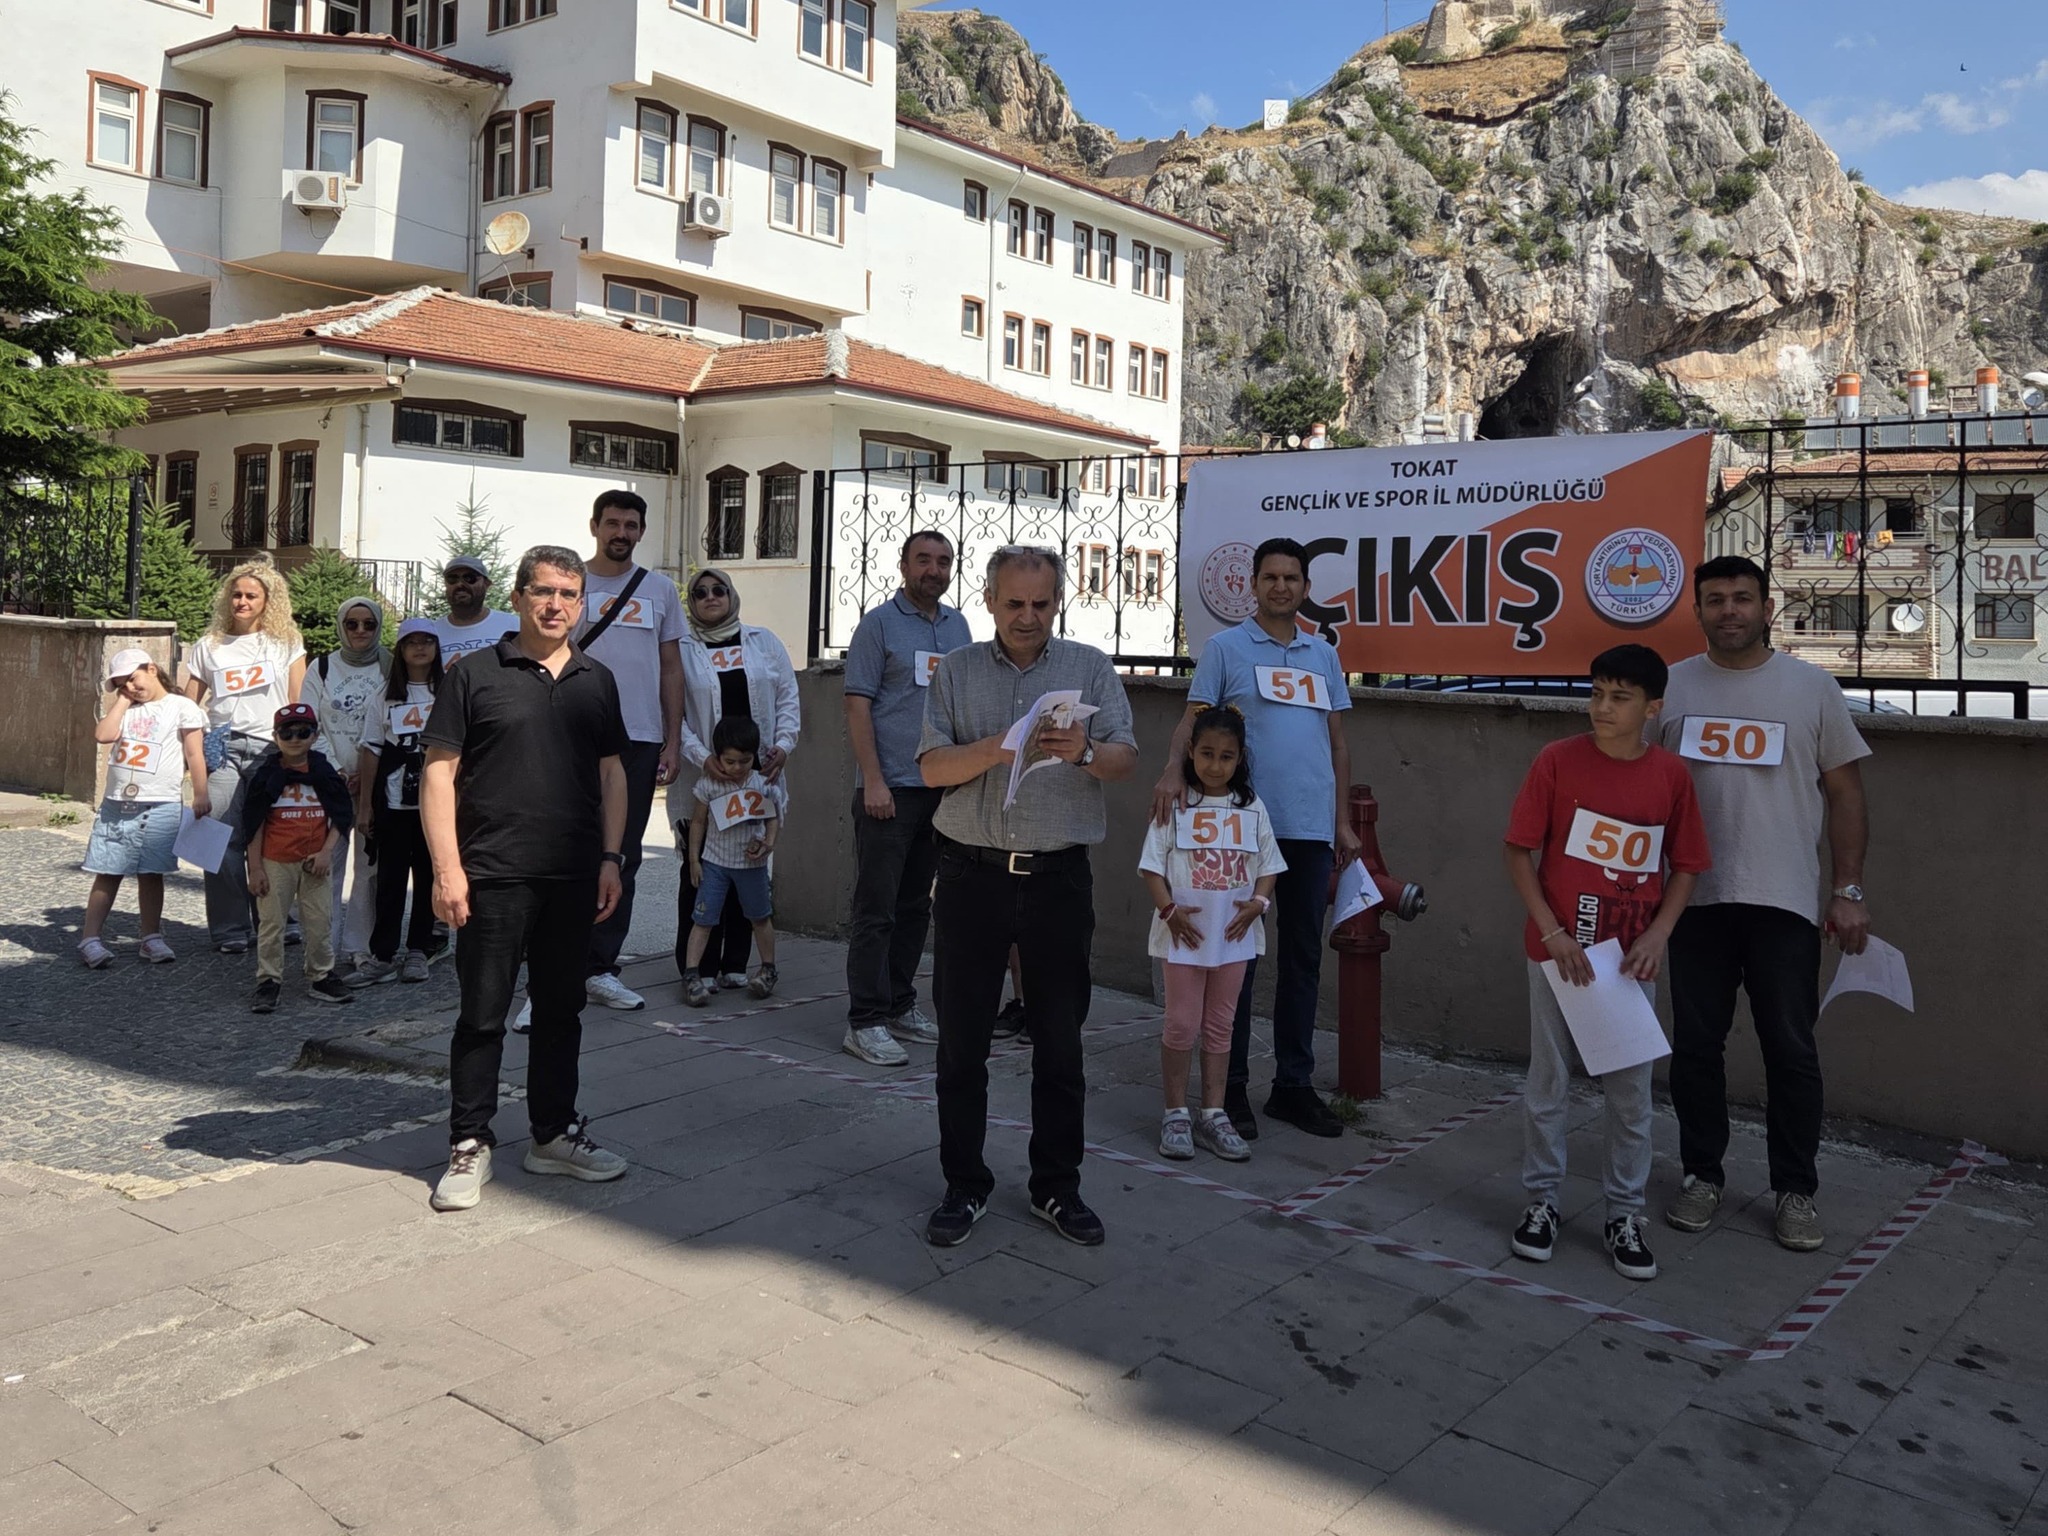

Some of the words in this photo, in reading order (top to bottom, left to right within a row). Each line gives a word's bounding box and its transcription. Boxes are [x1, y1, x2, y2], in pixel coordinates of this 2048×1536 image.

[1391, 459, 1458, 478] TOKAT
[1261, 490, 1341, 514] GENÇLİK
[1345, 492, 1369, 508] VE
[1374, 489, 1428, 507] SPOR
[1433, 485, 1450, 505] İL
[1456, 478, 1604, 504] MÜDÜRLÜĞÜ
[225, 666, 265, 691] 52
[1272, 671, 1316, 704] 51
[1699, 722, 1767, 760] 50
[281, 811, 302, 819] SURF
[726, 791, 765, 819] 42
[1192, 812, 1242, 845] 51
[1586, 820, 1652, 867] 50
